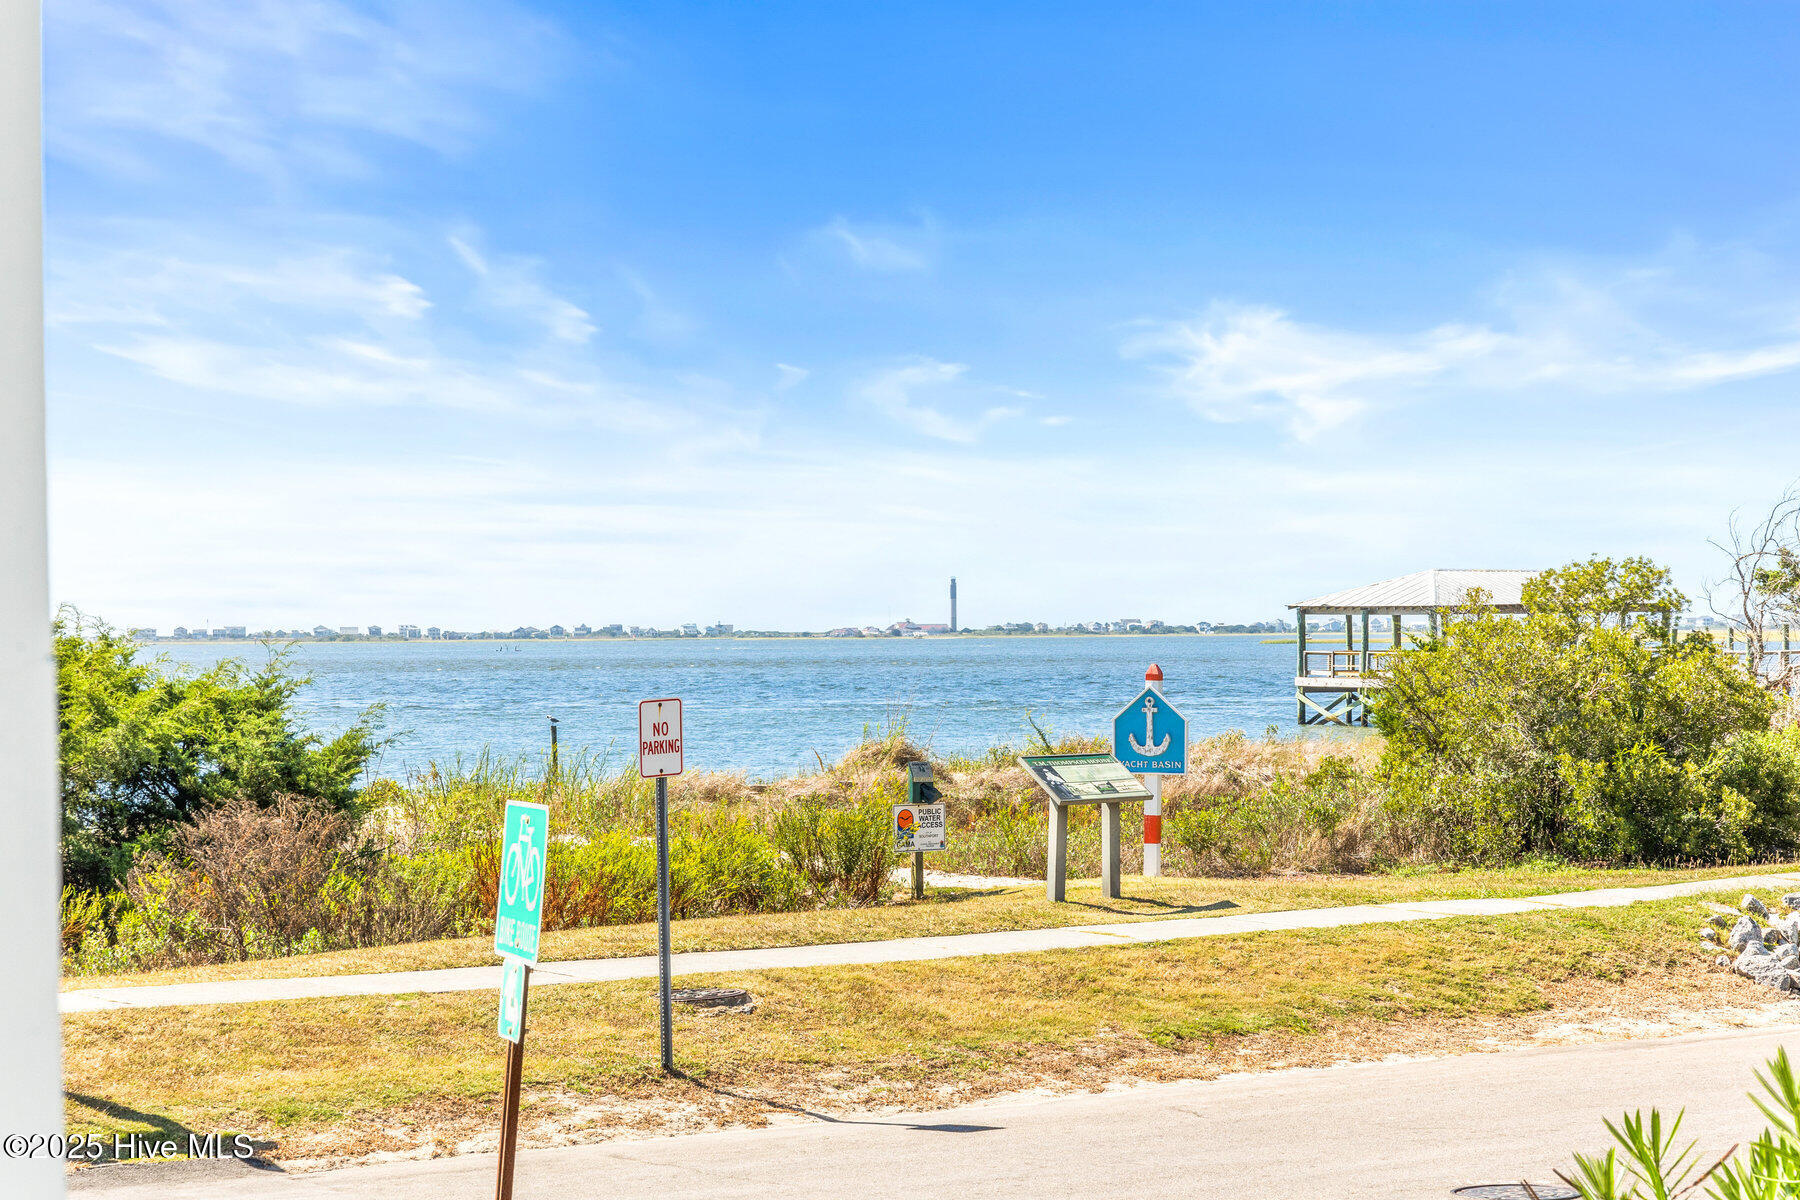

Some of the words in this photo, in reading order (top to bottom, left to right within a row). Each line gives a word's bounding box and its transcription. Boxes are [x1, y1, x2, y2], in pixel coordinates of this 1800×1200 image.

[652, 721, 669, 737] NO
[642, 738, 680, 756] PARKING
[1152, 760, 1182, 769] BASIN
[498, 915, 515, 947] BIKE
[514, 920, 537, 954] ROUTE
